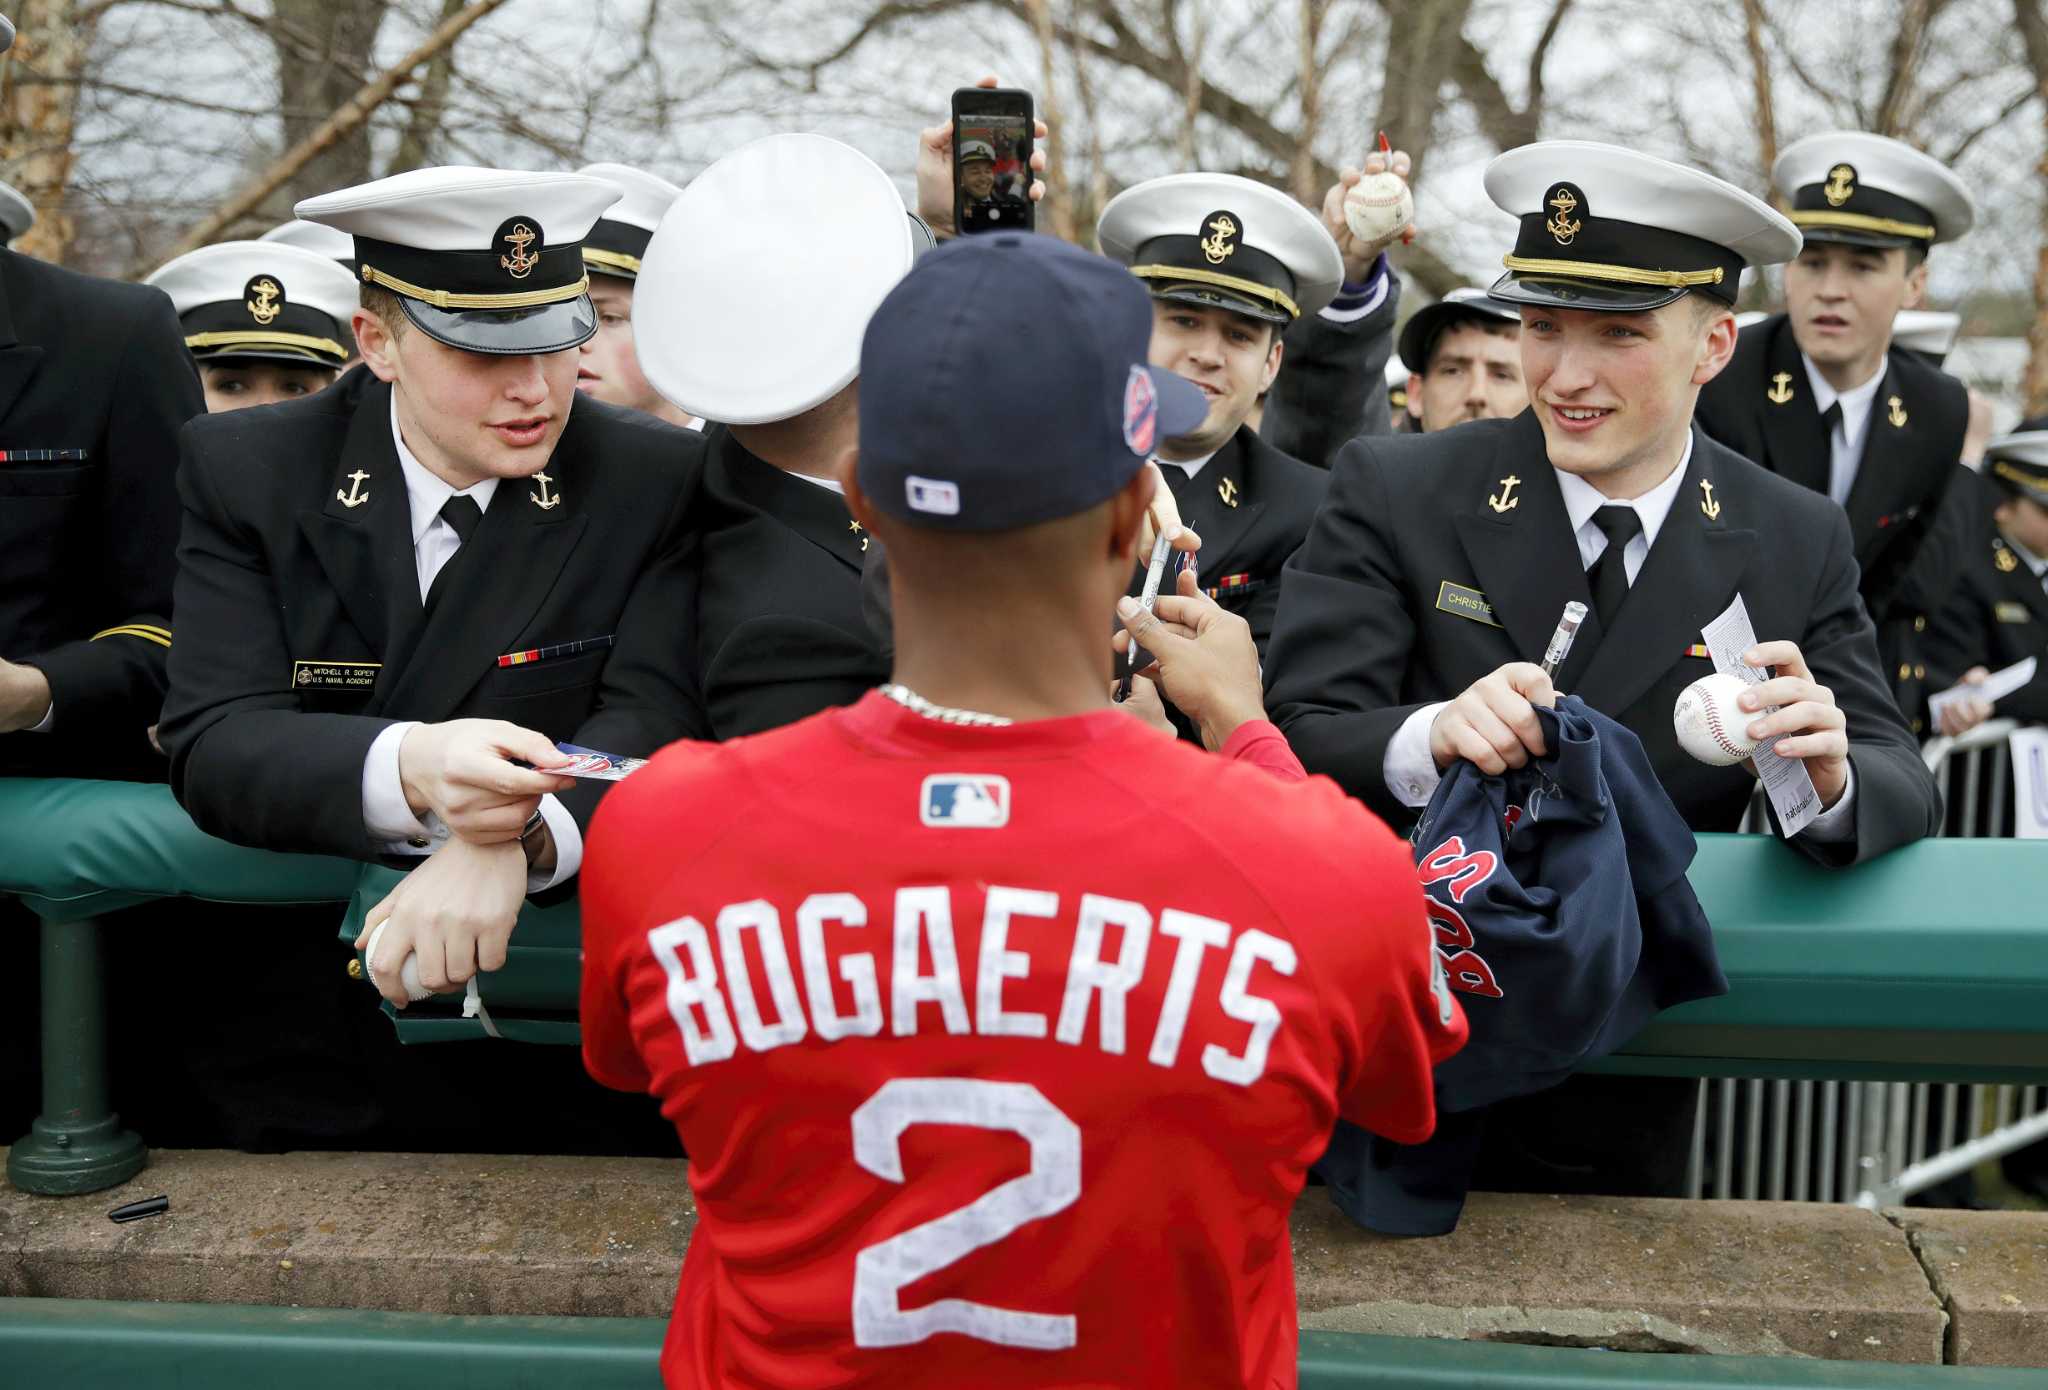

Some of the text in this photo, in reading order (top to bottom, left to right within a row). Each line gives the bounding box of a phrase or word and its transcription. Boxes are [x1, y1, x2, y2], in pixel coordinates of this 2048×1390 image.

[1448, 592, 1493, 614] CHRISTIE
[353, 669, 375, 677] SOPER
[647, 885, 1298, 1088] BOGAERTS
[850, 1077, 1082, 1351] 2
